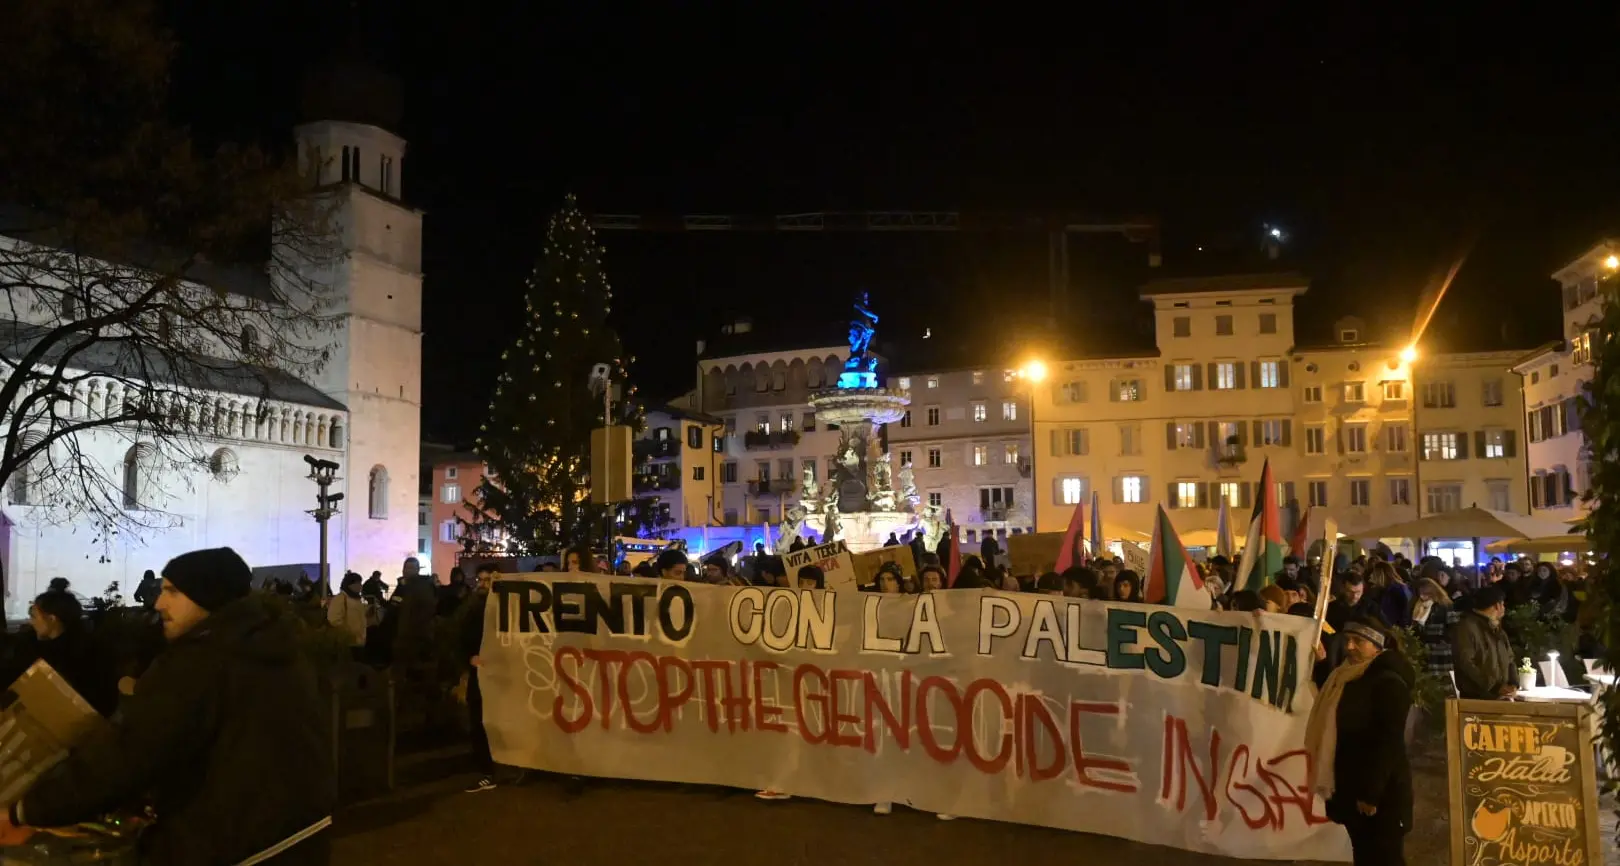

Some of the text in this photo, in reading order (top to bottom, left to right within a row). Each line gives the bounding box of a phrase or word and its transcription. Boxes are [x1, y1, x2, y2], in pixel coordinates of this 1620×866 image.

[785, 540, 848, 567] VITA TERRA
[492, 580, 1297, 714] TRENTO CON LA PALESTINA
[553, 646, 1330, 832] STOP THE GENOCIDE IN GAZ
[1478, 756, 1571, 783] Italia
